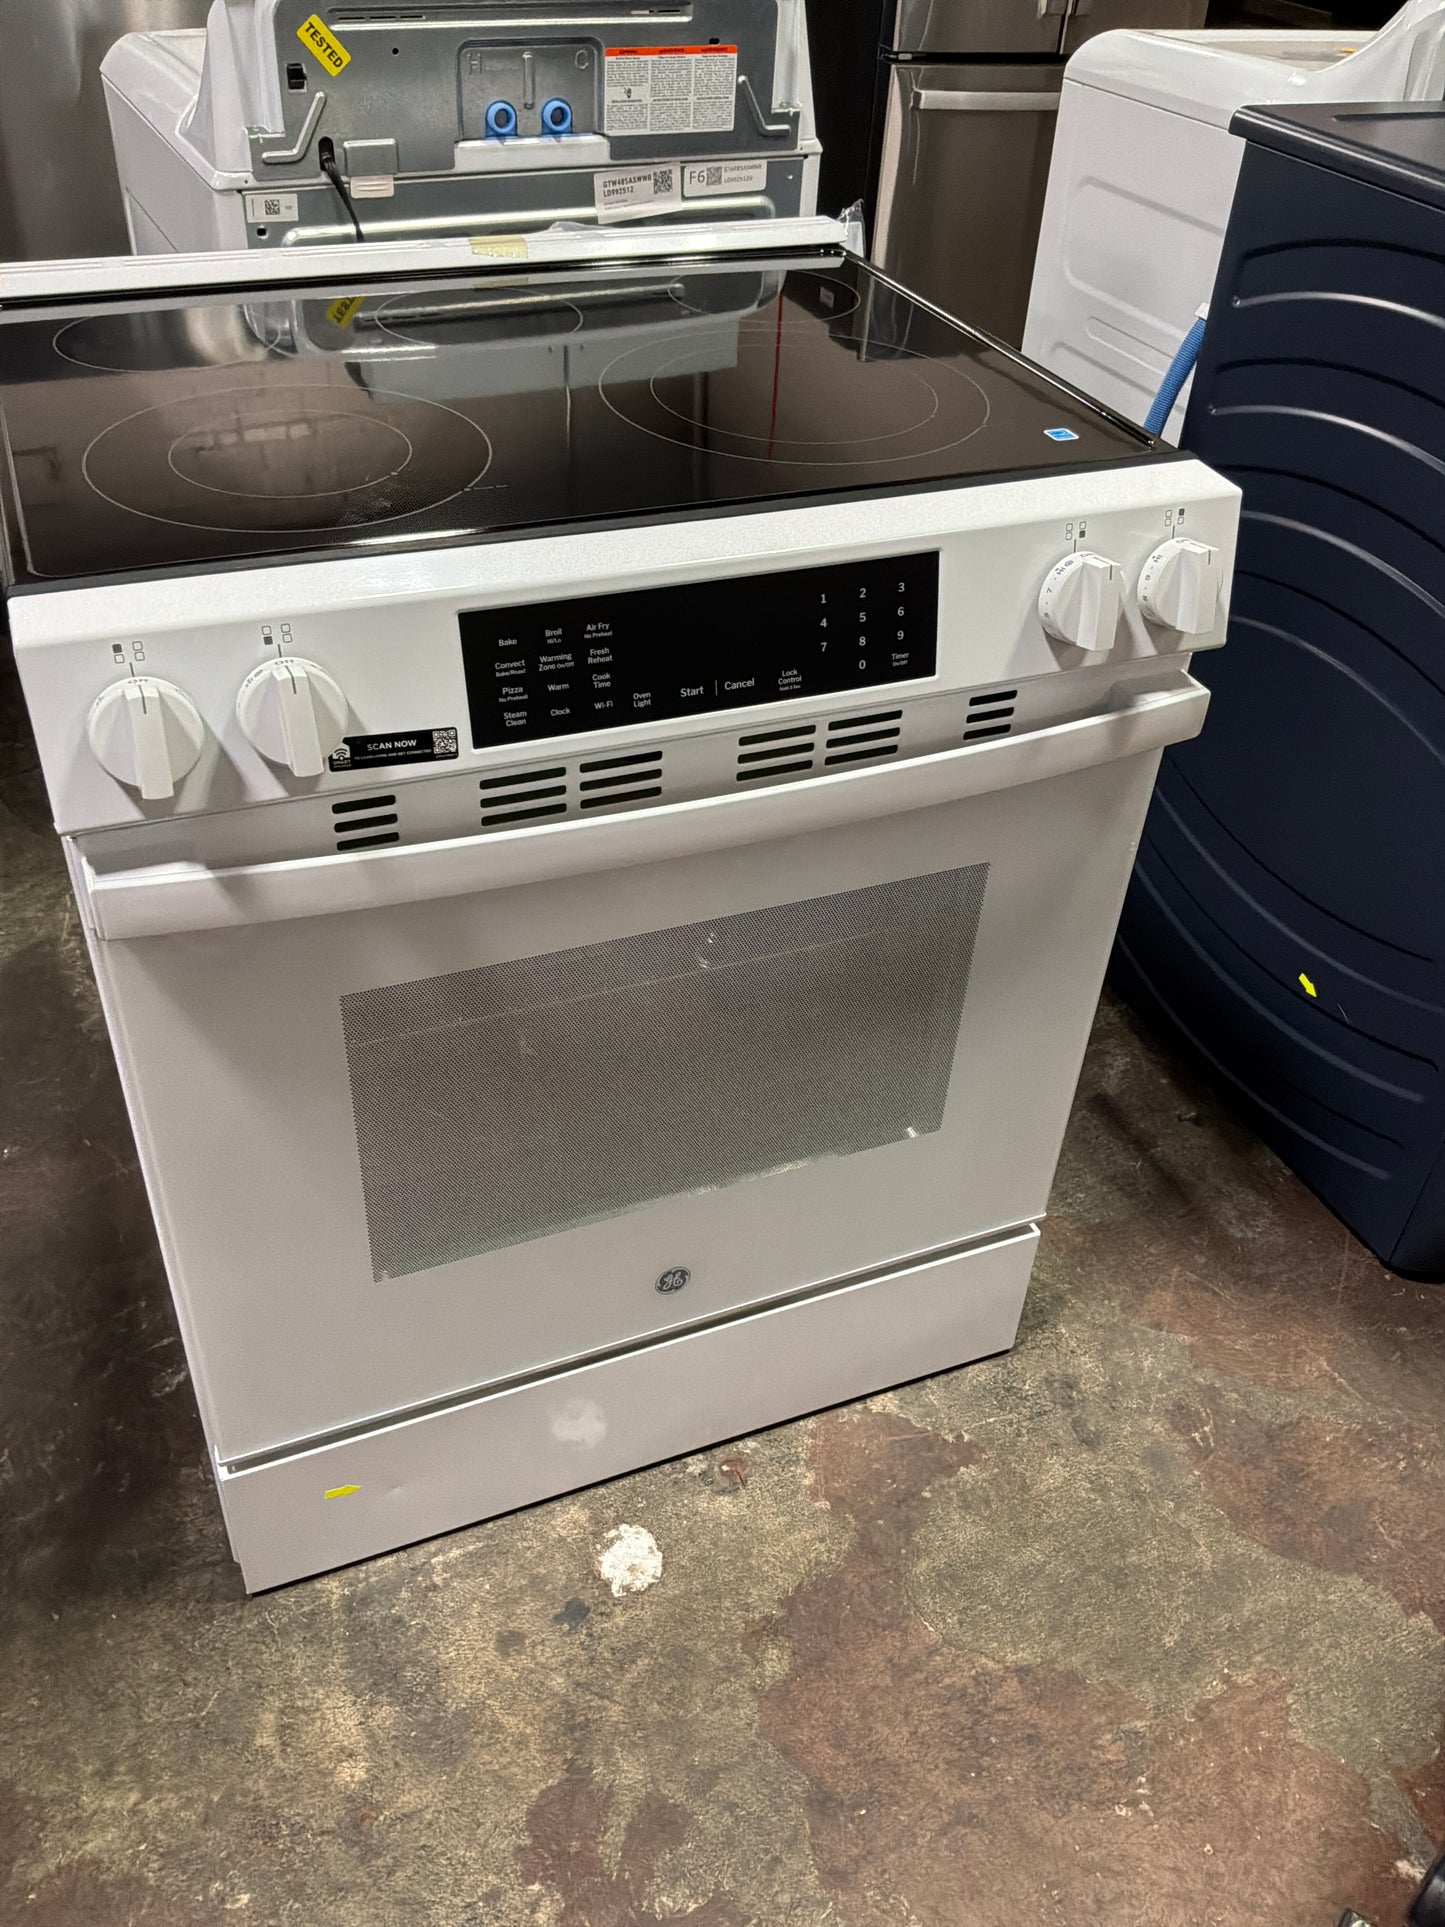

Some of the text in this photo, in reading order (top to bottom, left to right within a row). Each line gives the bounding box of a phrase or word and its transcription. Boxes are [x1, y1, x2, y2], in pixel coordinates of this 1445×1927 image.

[305, 21, 343, 68] TESTED
[689, 170, 706, 184] F6
[898, 582, 905, 592] 3
[859, 588, 867, 598] 2
[820, 593, 827, 604] 1
[897, 607, 905, 616] 6
[859, 612, 866, 622] 5
[586, 622, 610, 632] Air Fry
[820, 618, 828, 628] 4
[545, 628, 562, 637] Broil
[897, 631, 904, 641] 9
[498, 638, 518, 647] Bake
[859, 637, 866, 646] 8
[589, 647, 610, 657] Fresh
[821, 642, 827, 652] 7
[539, 653, 572, 663] Warming
[587, 654, 613, 665] Reheat
[891, 652, 909, 660] Timer
[495, 660, 526, 670] Convect
[538, 663, 556, 672] Zone
[859, 660, 866, 669] 0
[592, 673, 611, 681] Cook
[782, 668, 798, 677] Lock
[593, 680, 611, 689] Time
[724, 678, 755, 691] Cancel
[778, 675, 802, 685] Control
[502, 686, 523, 695] Pizza
[548, 682, 569, 692] Warm
[680, 685, 704, 697] Start
[633, 692, 651, 700] Oven
[594, 701, 613, 709] Wi-Fi
[633, 699, 652, 708] Light
[503, 710, 527, 720] Steam
[550, 707, 571, 717] Clock
[505, 718, 527, 727] Clean
[367, 739, 417, 751] SCAN NOW
